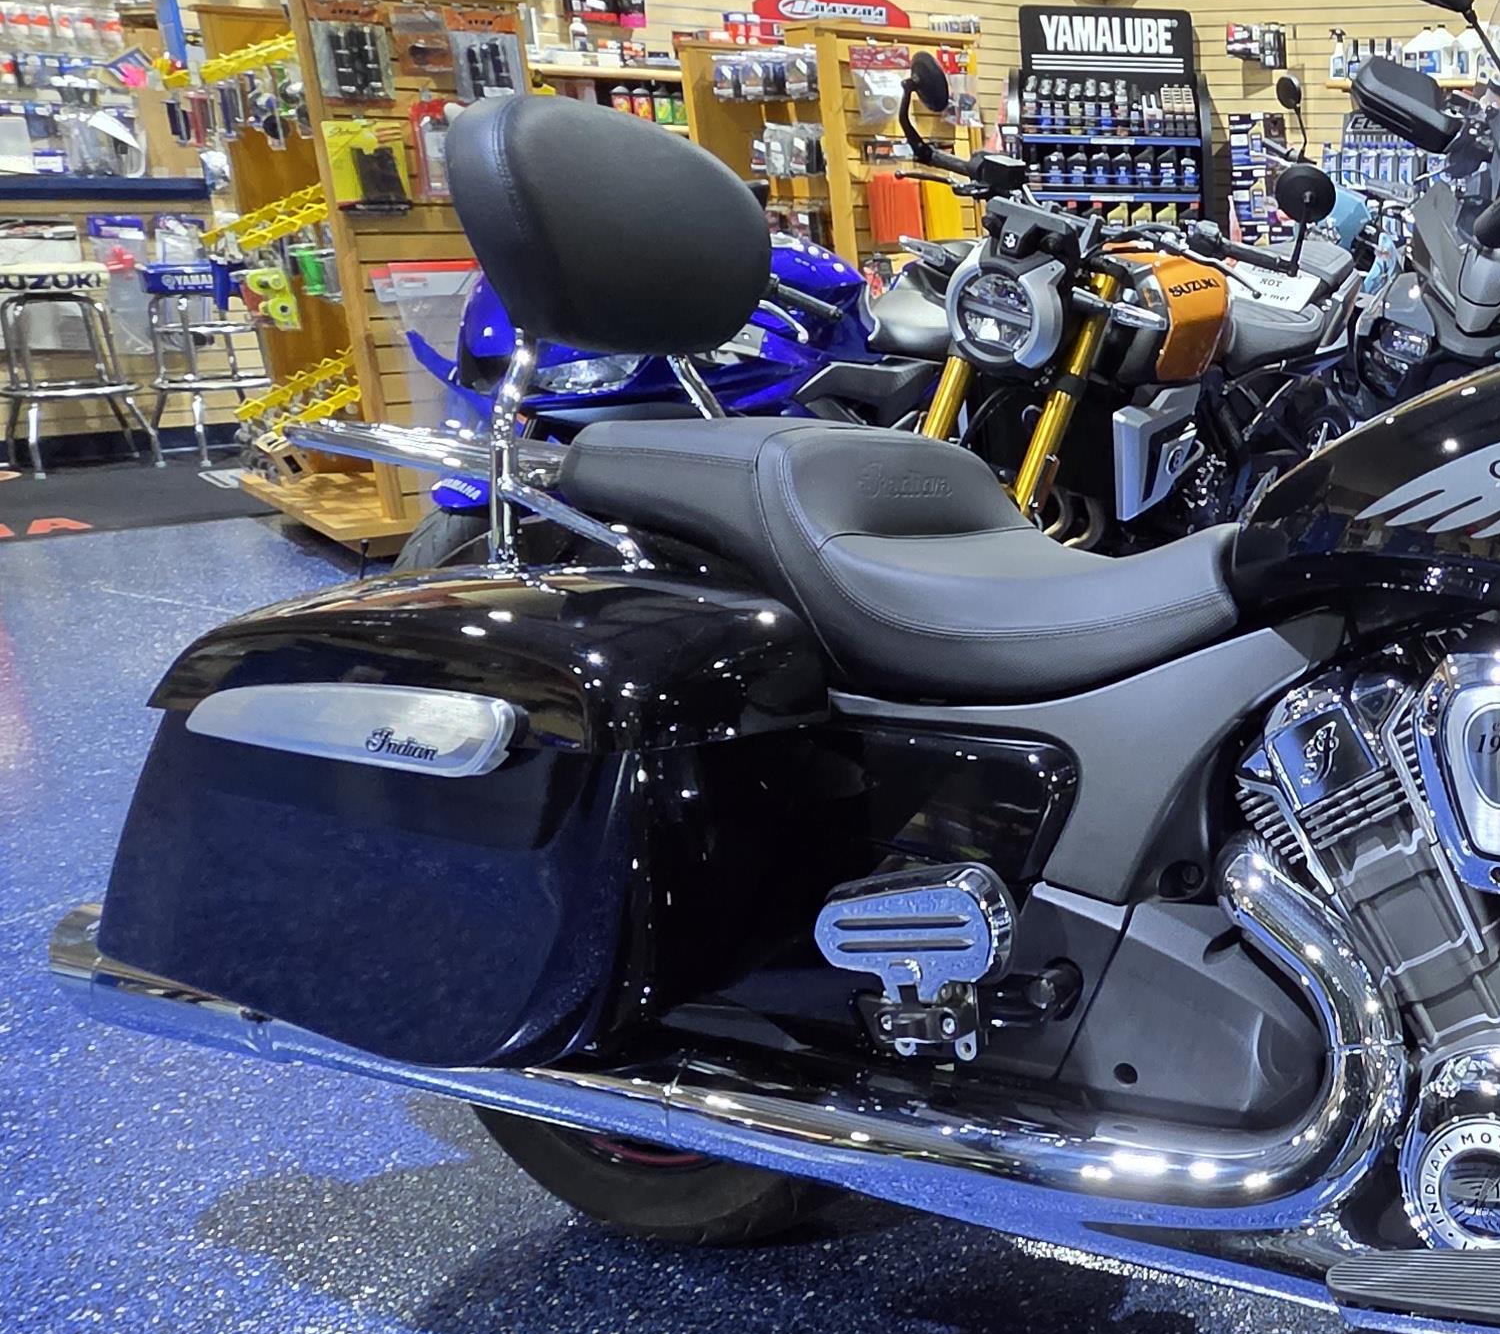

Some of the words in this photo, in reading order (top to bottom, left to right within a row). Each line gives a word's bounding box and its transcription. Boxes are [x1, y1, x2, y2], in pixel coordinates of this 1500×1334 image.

[1168, 277, 1220, 298] SUZUKI
[1259, 277, 1283, 288] NOT
[365, 727, 440, 762] Indian
[1424, 1142, 1454, 1226] INDIAN
